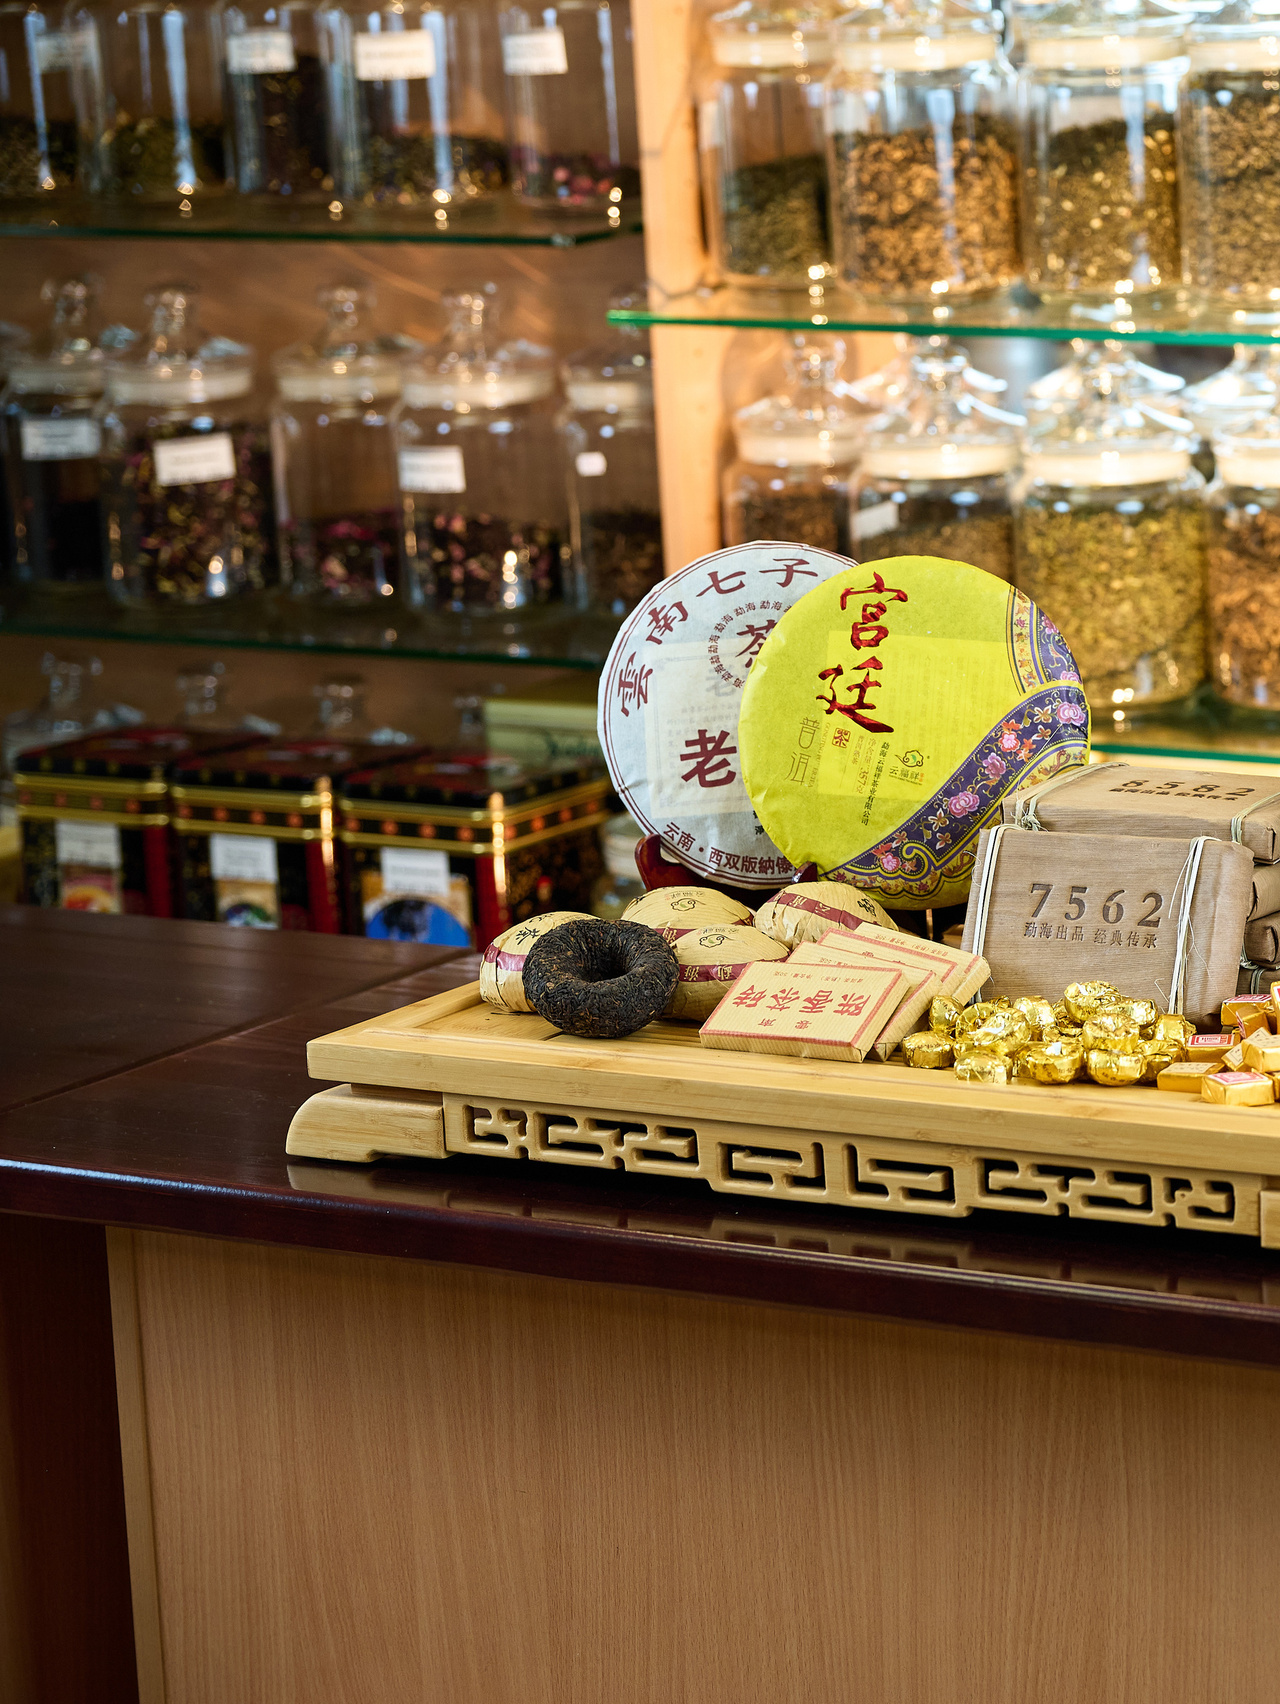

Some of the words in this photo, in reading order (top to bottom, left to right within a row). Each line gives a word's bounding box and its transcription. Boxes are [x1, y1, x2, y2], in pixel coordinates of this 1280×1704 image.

[618, 558, 822, 717] 雲南七子
[785, 717, 821, 786] 普洱
[832, 727, 851, 749] 茶
[680, 728, 738, 789] 老
[1122, 780, 1256, 797] 8582
[1030, 883, 1164, 929] 7562
[1023, 921, 1085, 942] 勐海出品
[1093, 928, 1158, 950] 经典传承
[685, 965, 733, 982] 勐海
